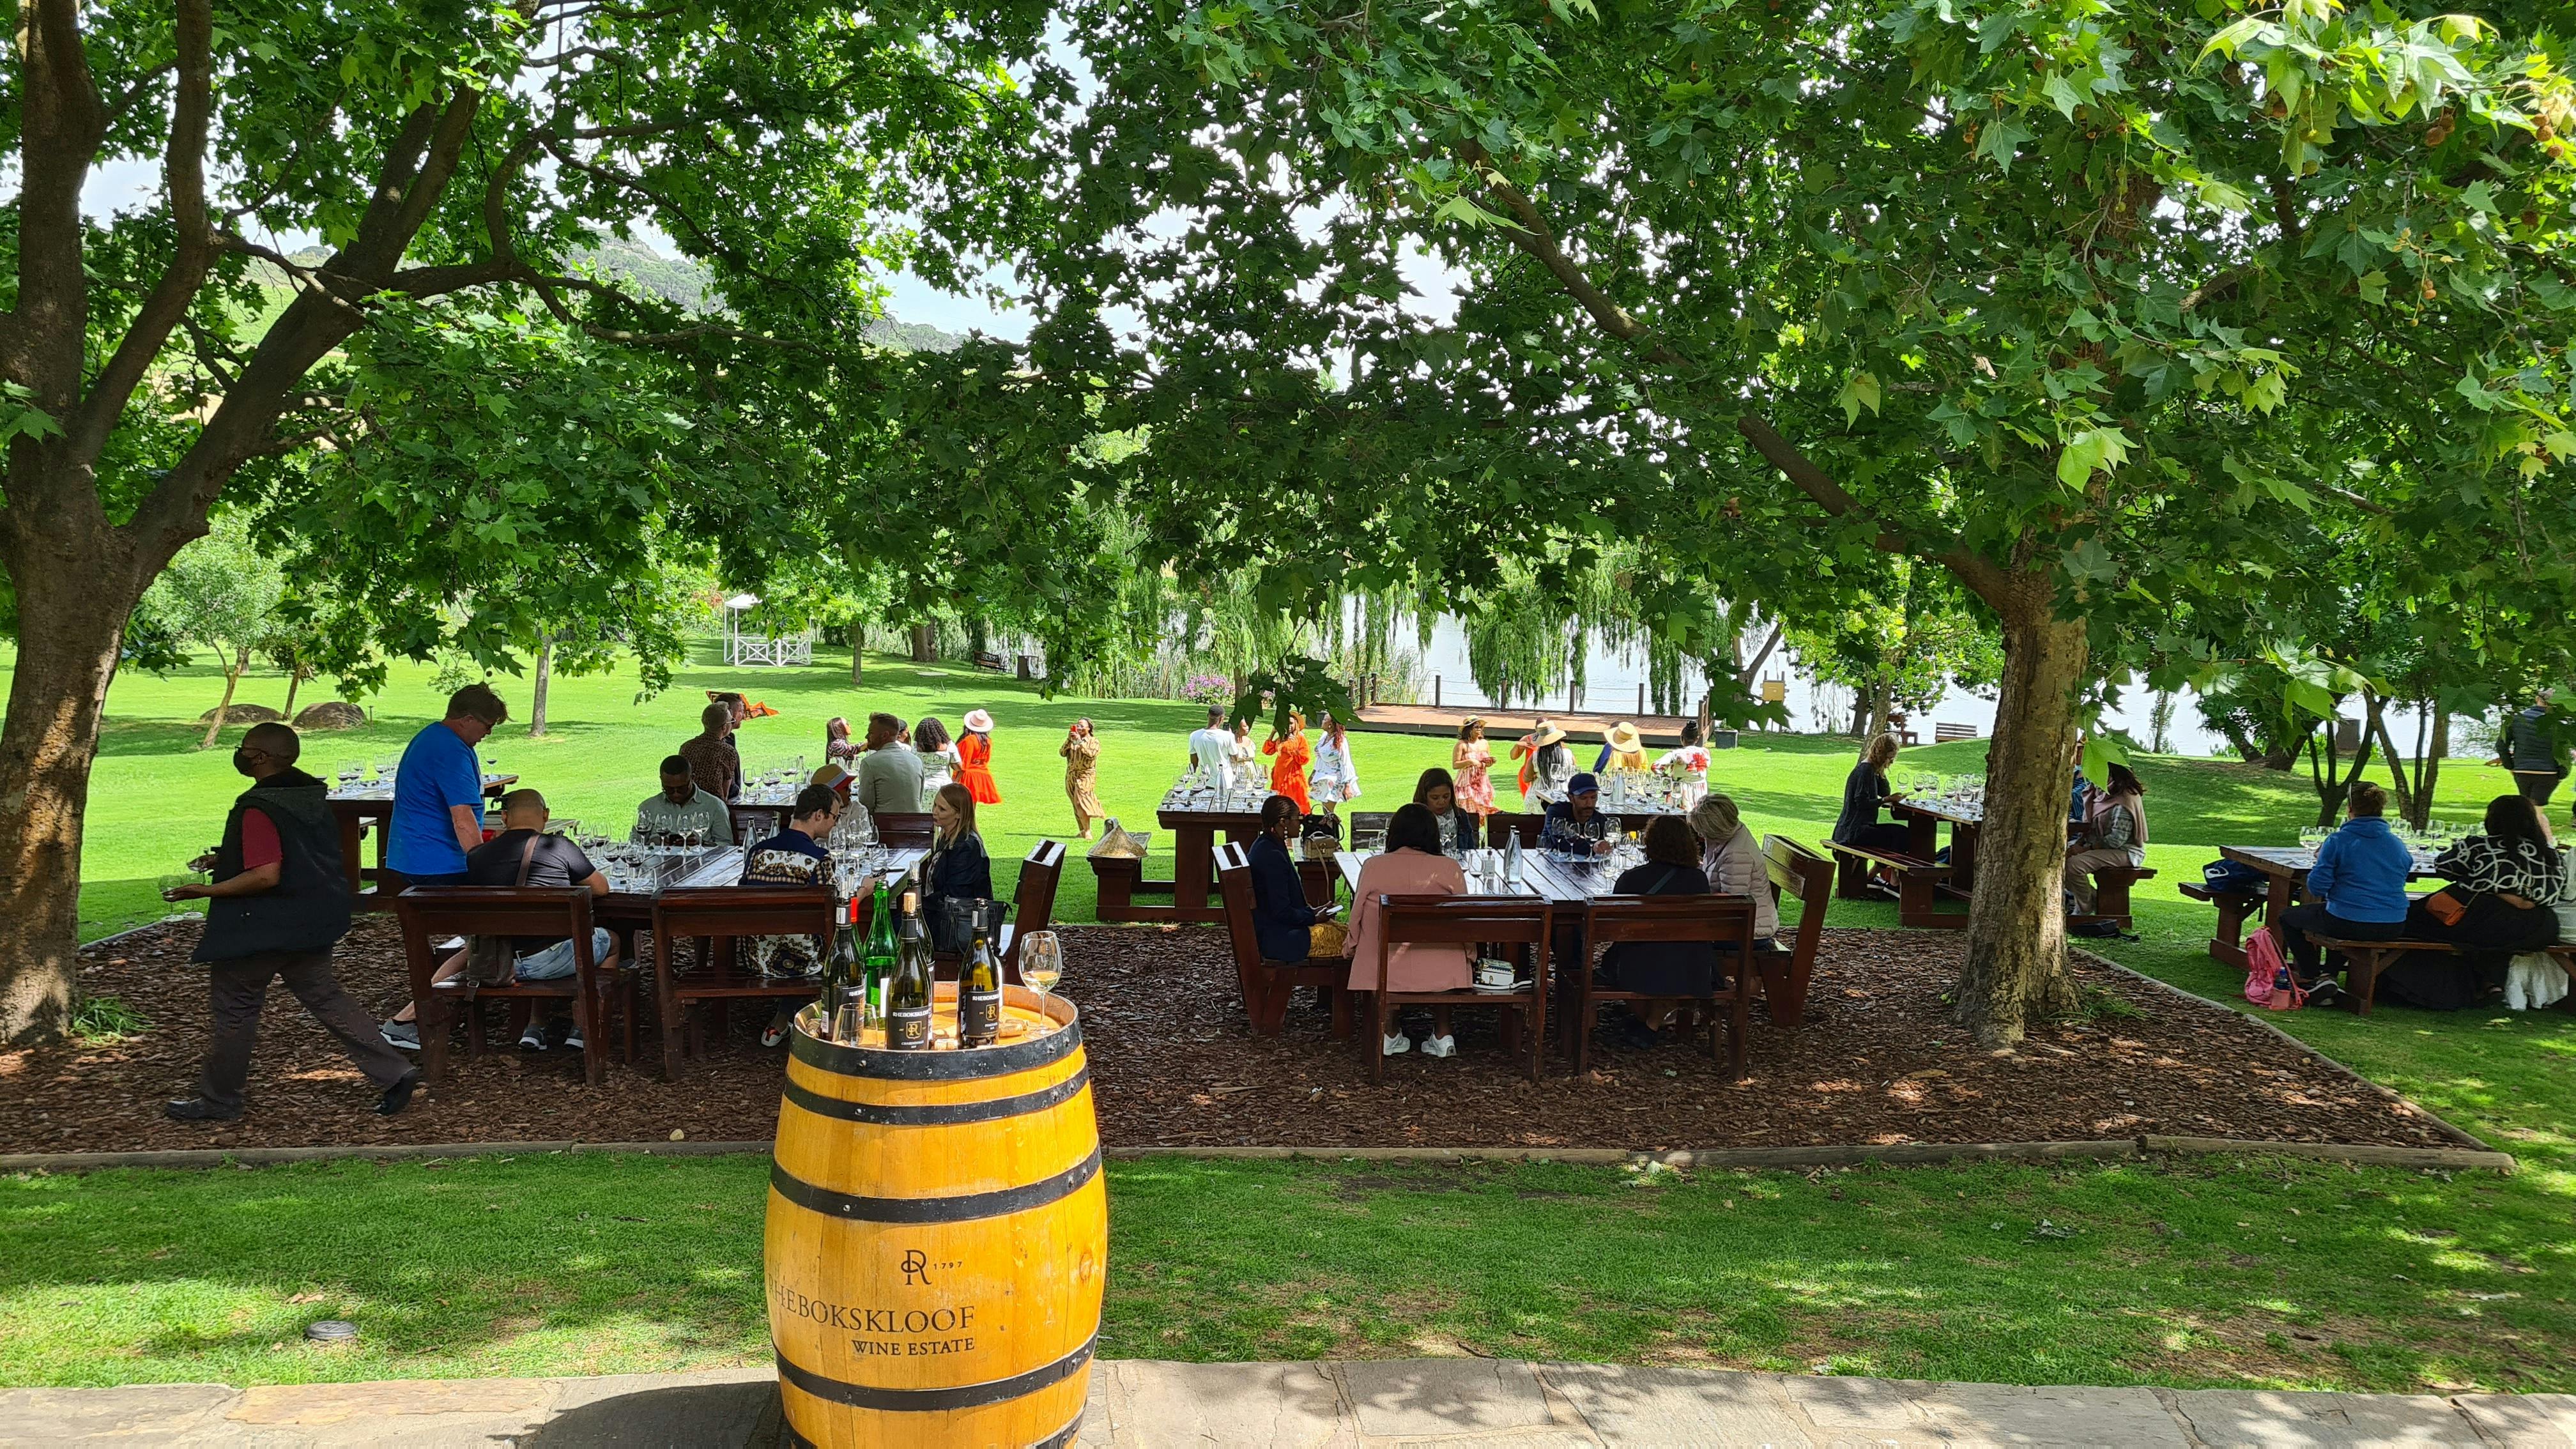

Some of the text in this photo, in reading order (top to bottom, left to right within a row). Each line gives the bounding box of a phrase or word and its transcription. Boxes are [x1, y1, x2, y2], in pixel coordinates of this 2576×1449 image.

[933, 1261, 962, 1269] 1797
[769, 1273, 975, 1333] RHEBOKSKLOOF
[852, 1337, 975, 1355] WINE ESTATE
